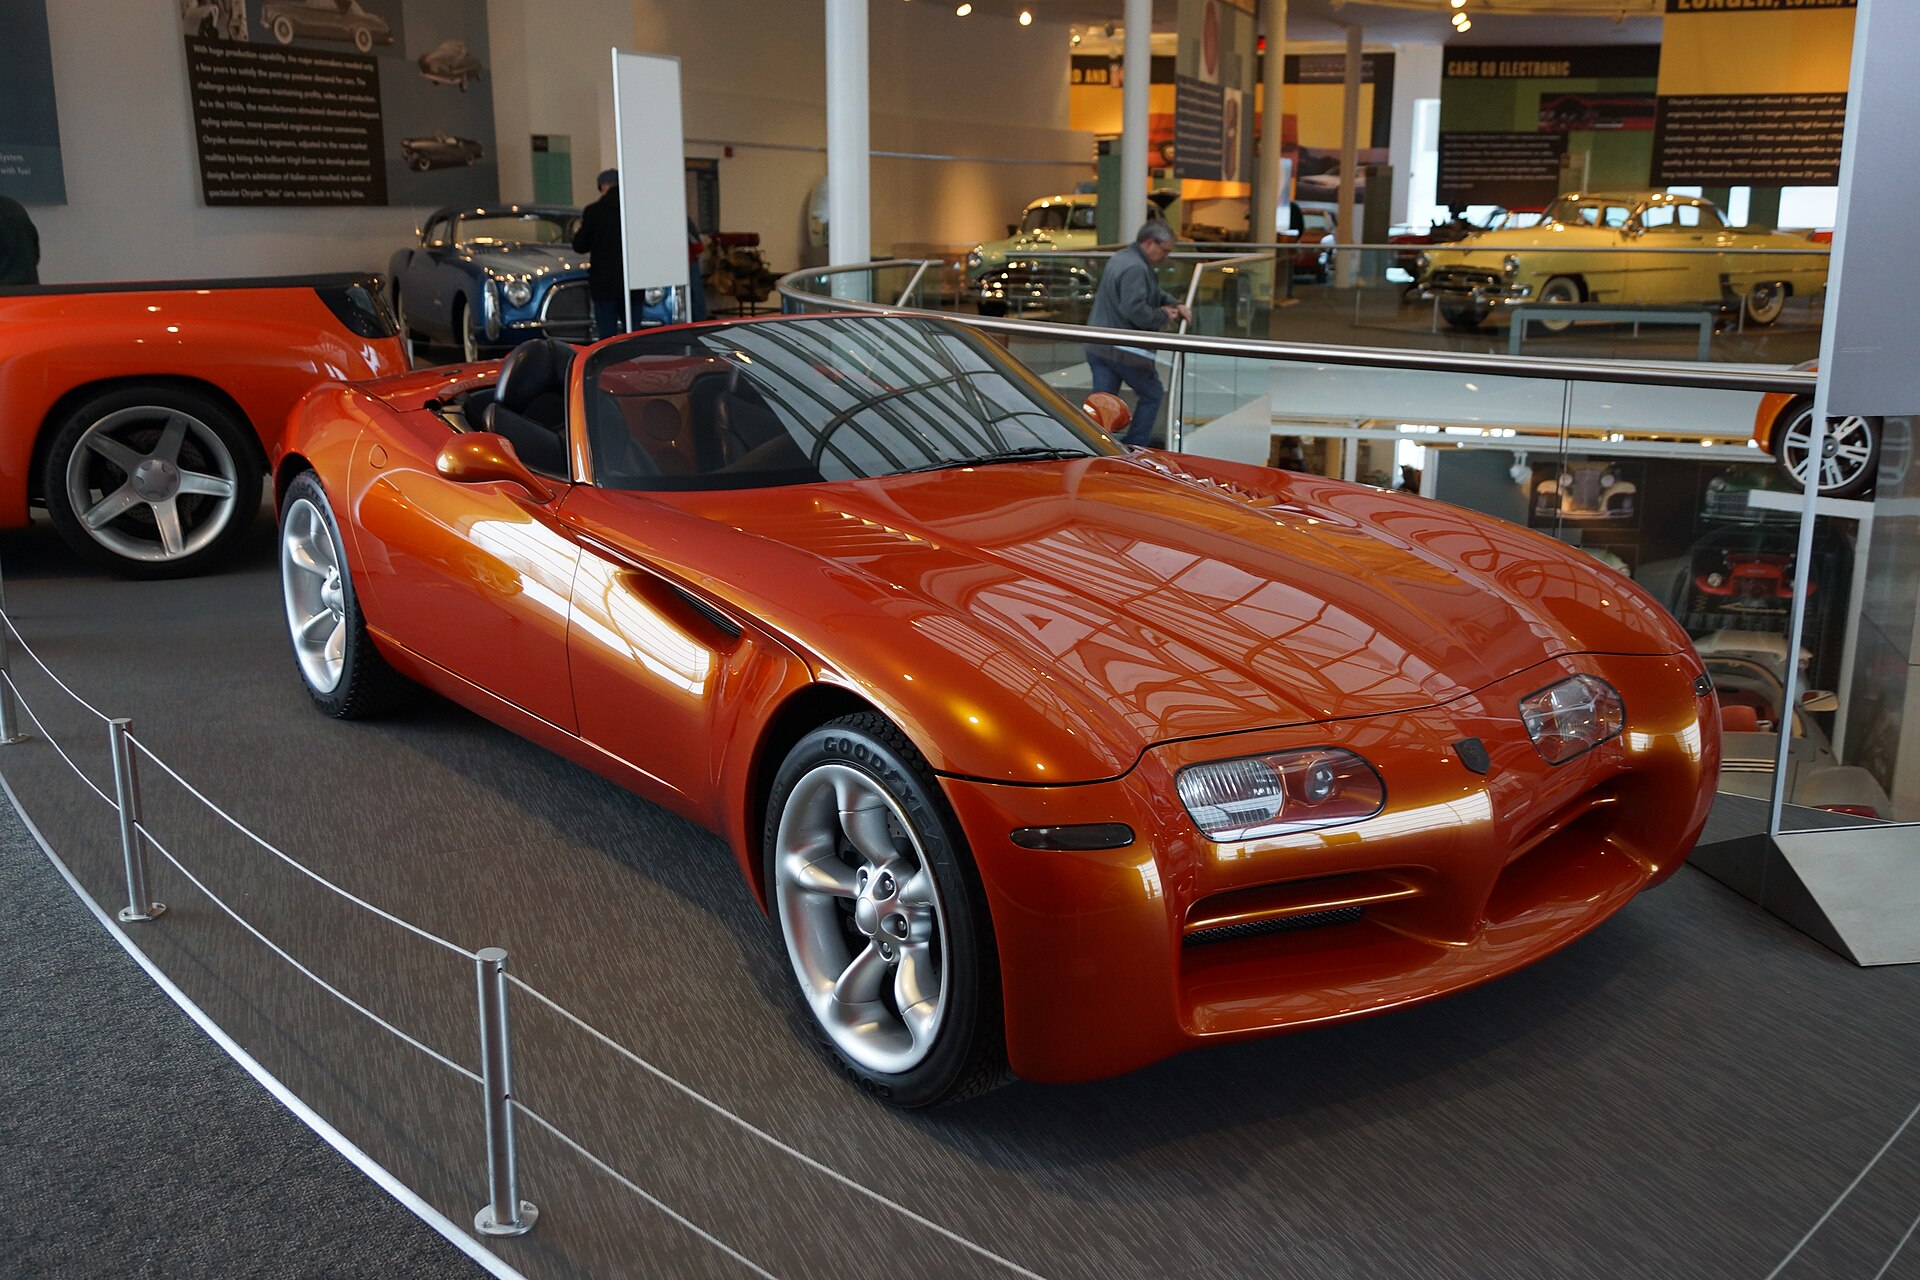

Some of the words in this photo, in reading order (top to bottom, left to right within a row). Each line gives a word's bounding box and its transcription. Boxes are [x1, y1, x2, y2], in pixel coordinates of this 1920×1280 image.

[1448, 61, 1478, 76] CARS
[1480, 61, 1497, 76] GO
[1499, 61, 1570, 76] ELECTRONIC
